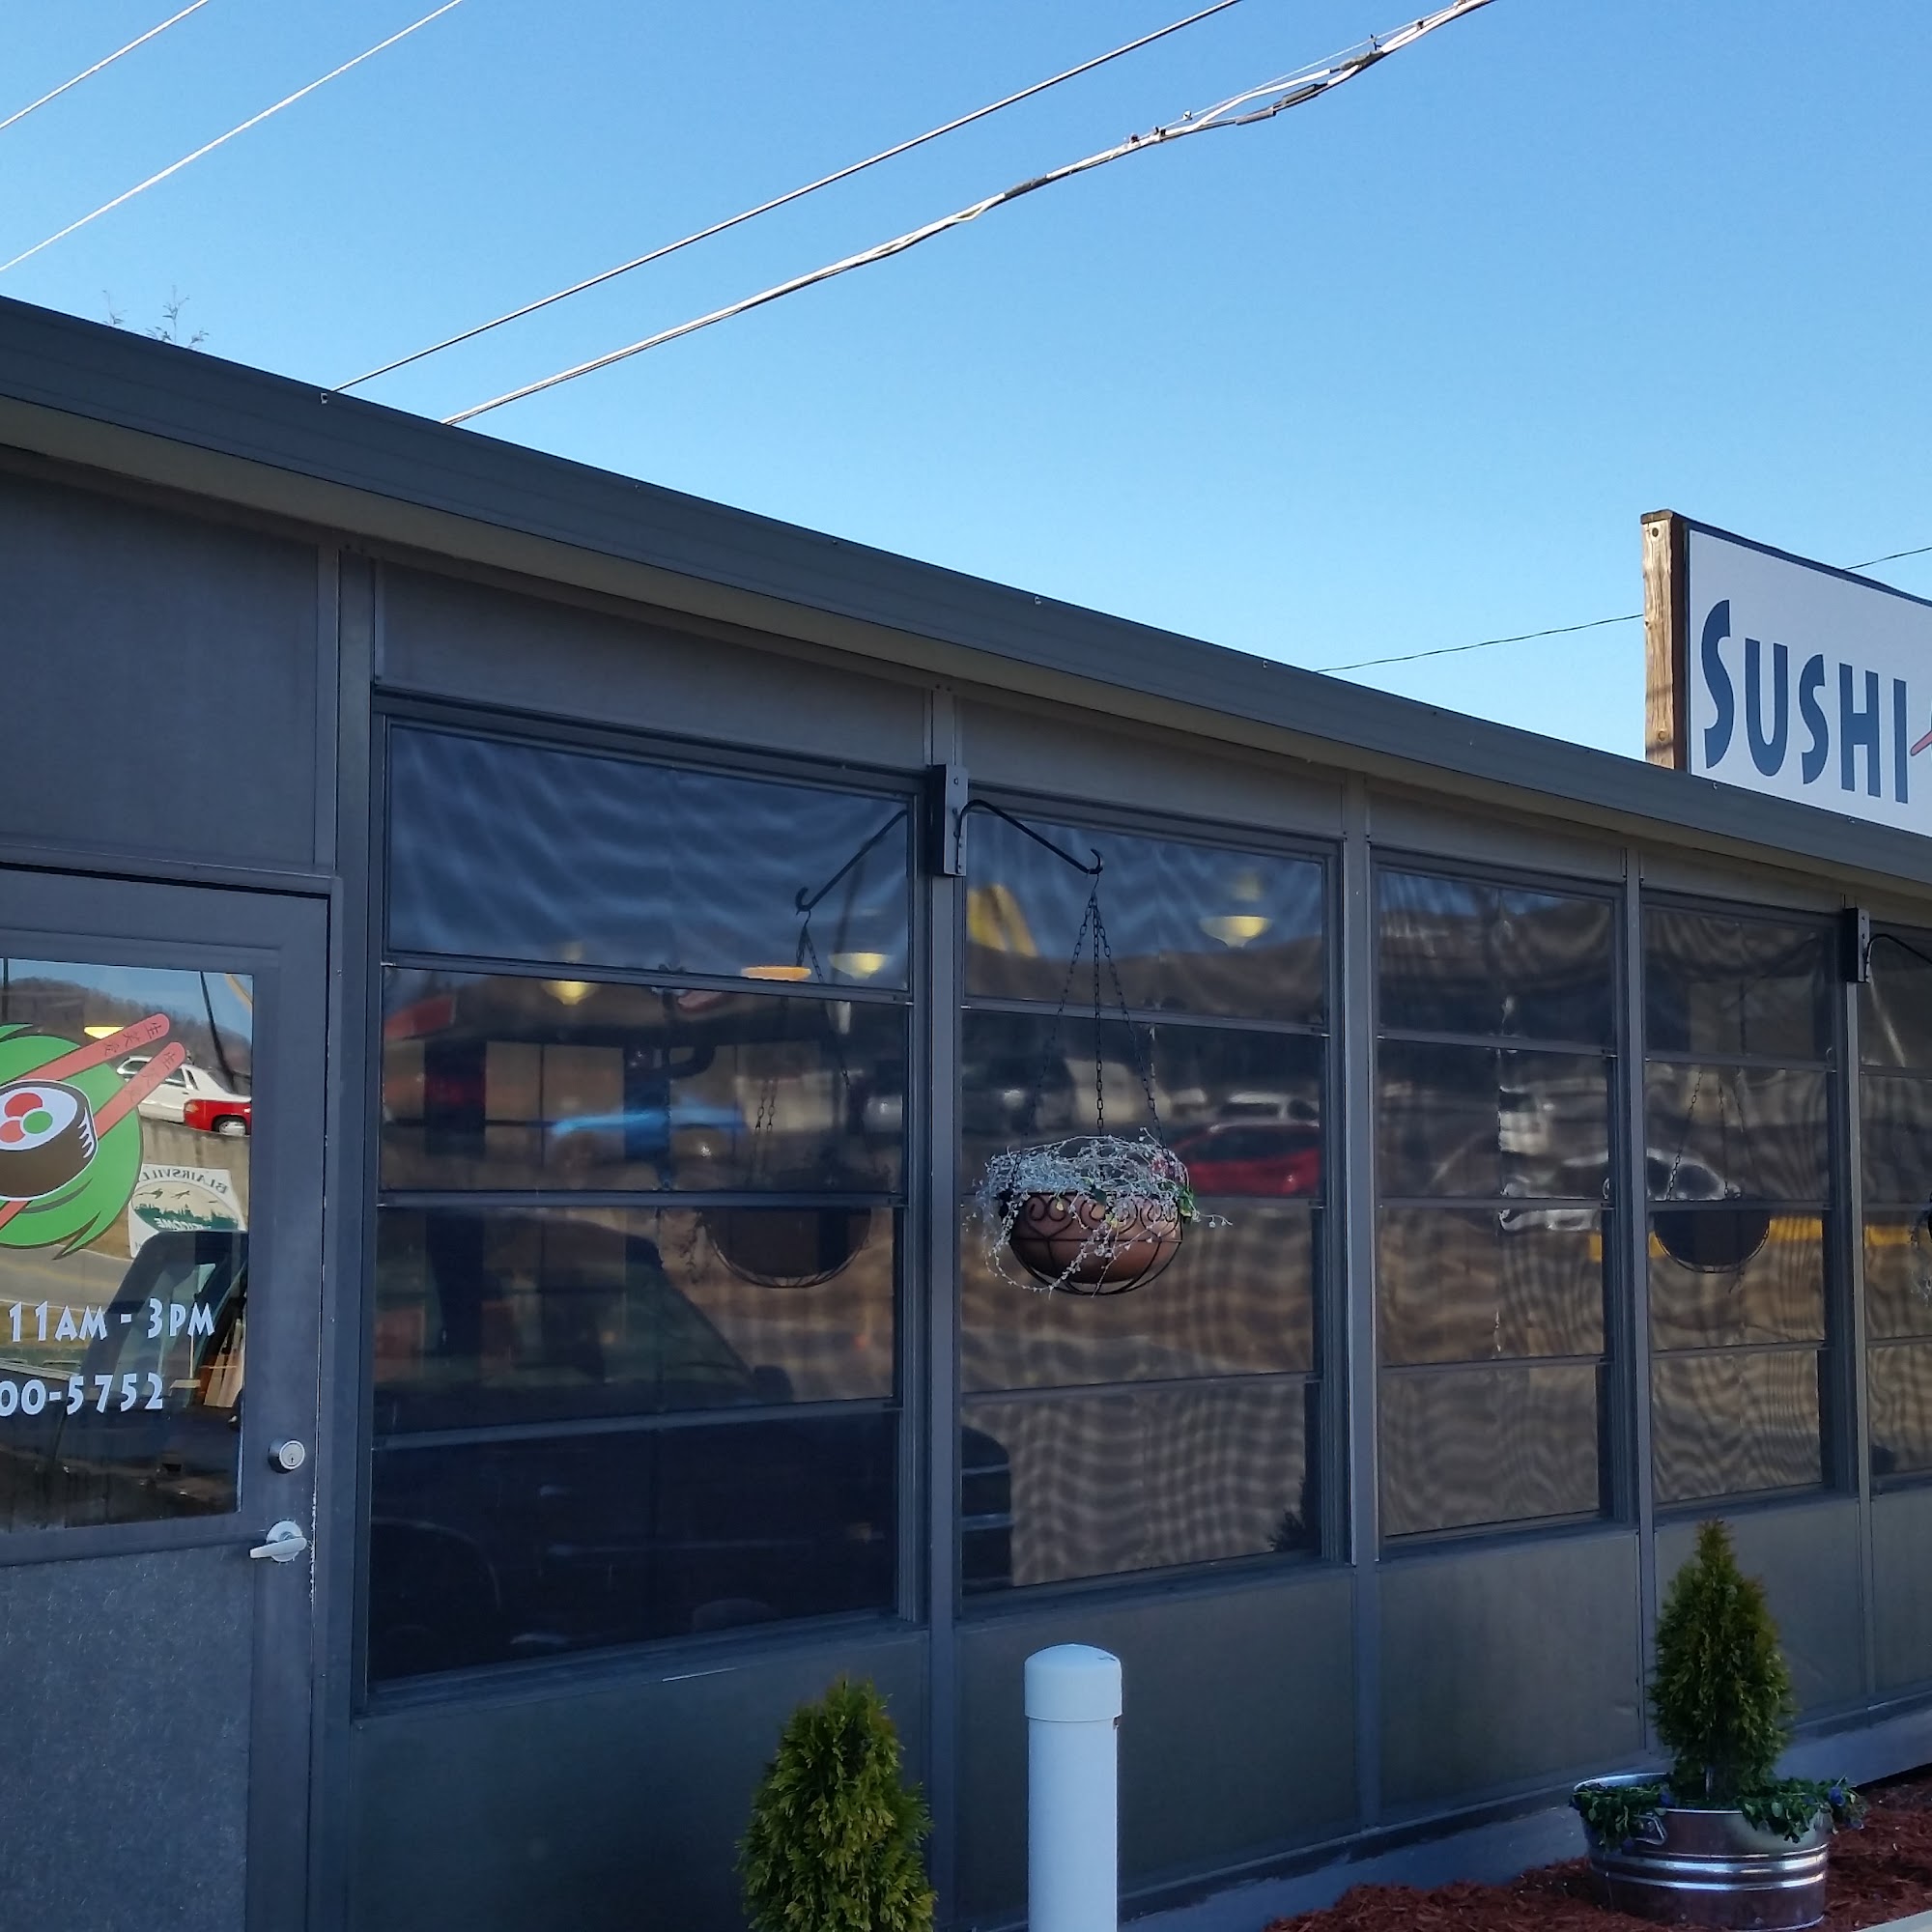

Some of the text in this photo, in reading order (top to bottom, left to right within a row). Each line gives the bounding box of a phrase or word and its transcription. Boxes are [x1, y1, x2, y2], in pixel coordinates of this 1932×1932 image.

[1701, 599, 1908, 804] SUSHI
[9, 1300, 108, 1343] 11AM
[147, 1297, 215, 1339] 3PM
[0, 1372, 163, 1417] 00-5752
